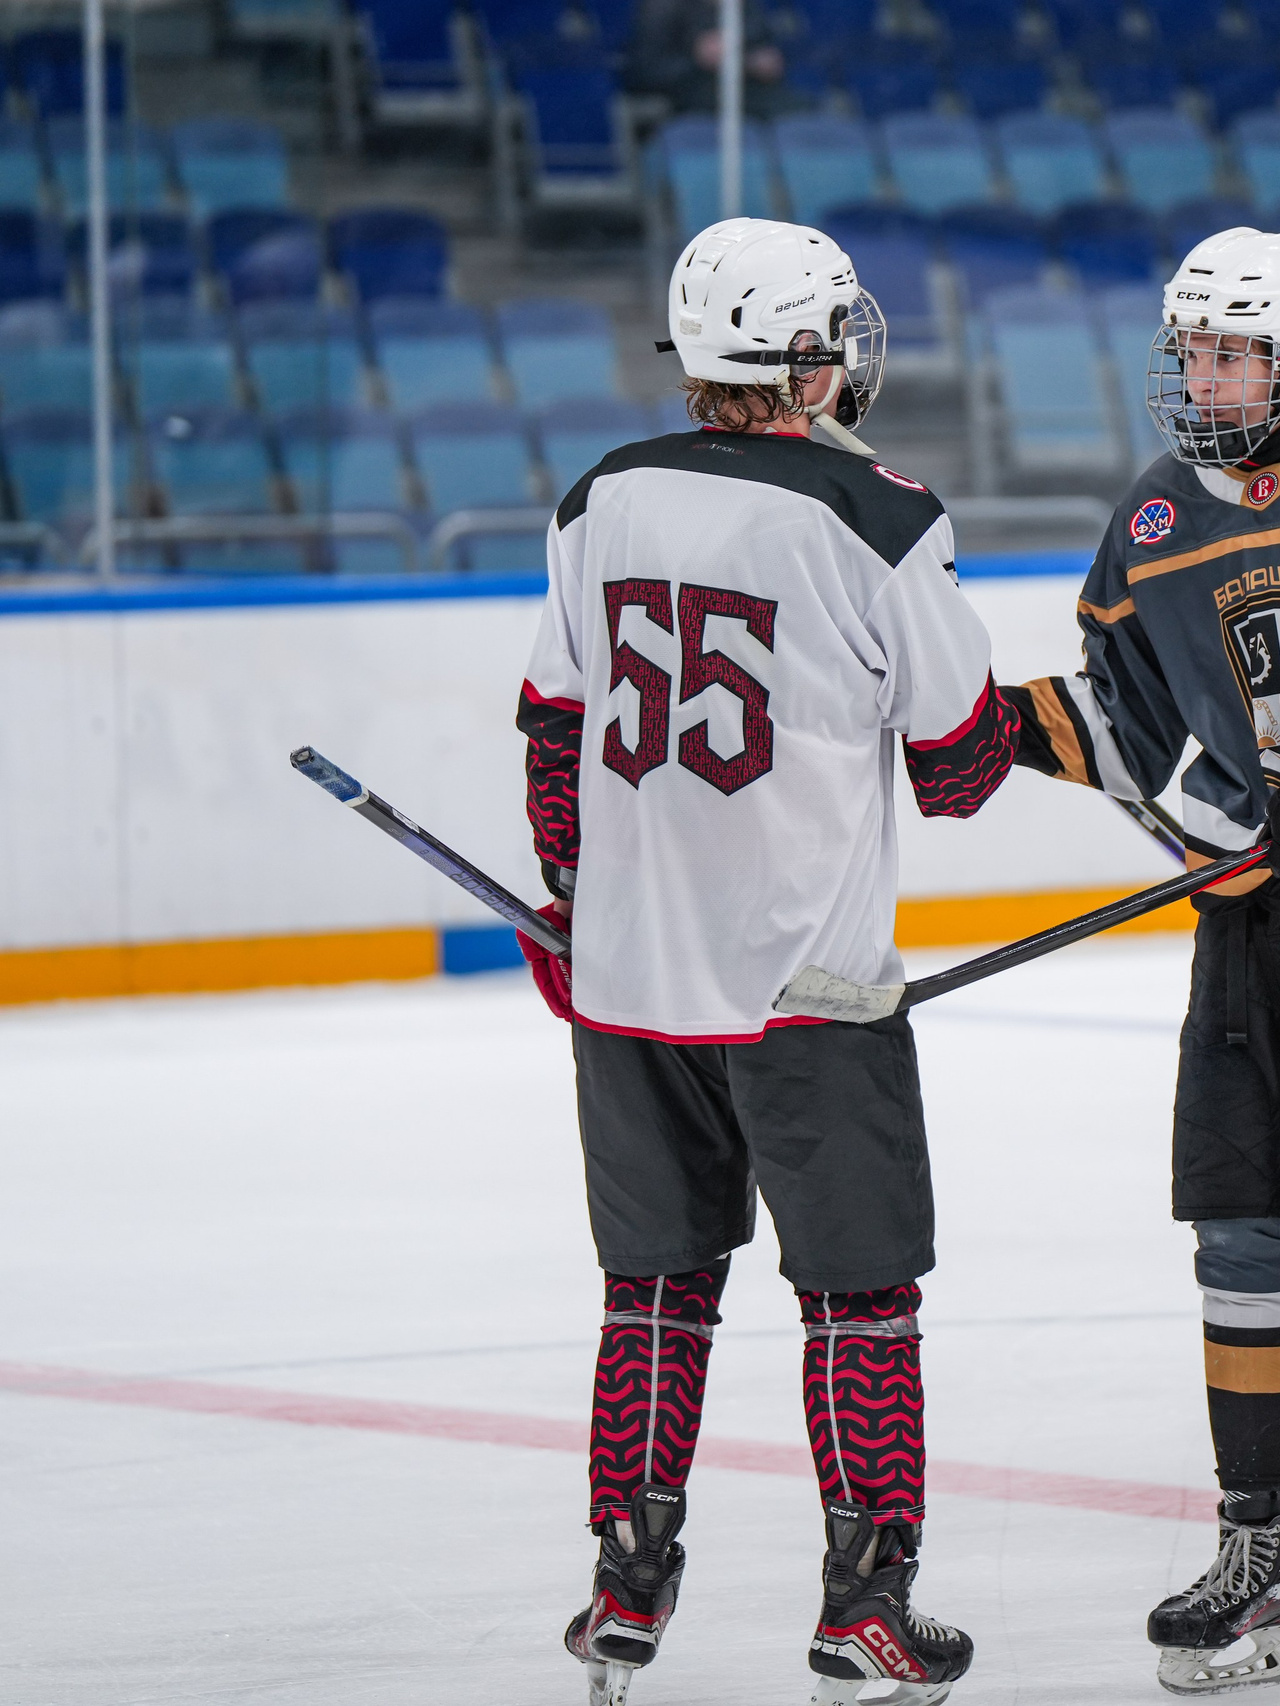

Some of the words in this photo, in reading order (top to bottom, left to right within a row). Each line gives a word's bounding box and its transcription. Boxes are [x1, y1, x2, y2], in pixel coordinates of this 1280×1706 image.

[1177, 291, 1211, 302] CCM
[775, 293, 815, 314] BAUER
[1182, 438, 1215, 448] CCM
[602, 577, 779, 797] 55
[646, 1491, 680, 1503] CCM
[829, 1506, 859, 1519] CCM
[863, 1622, 922, 1682] CCM
